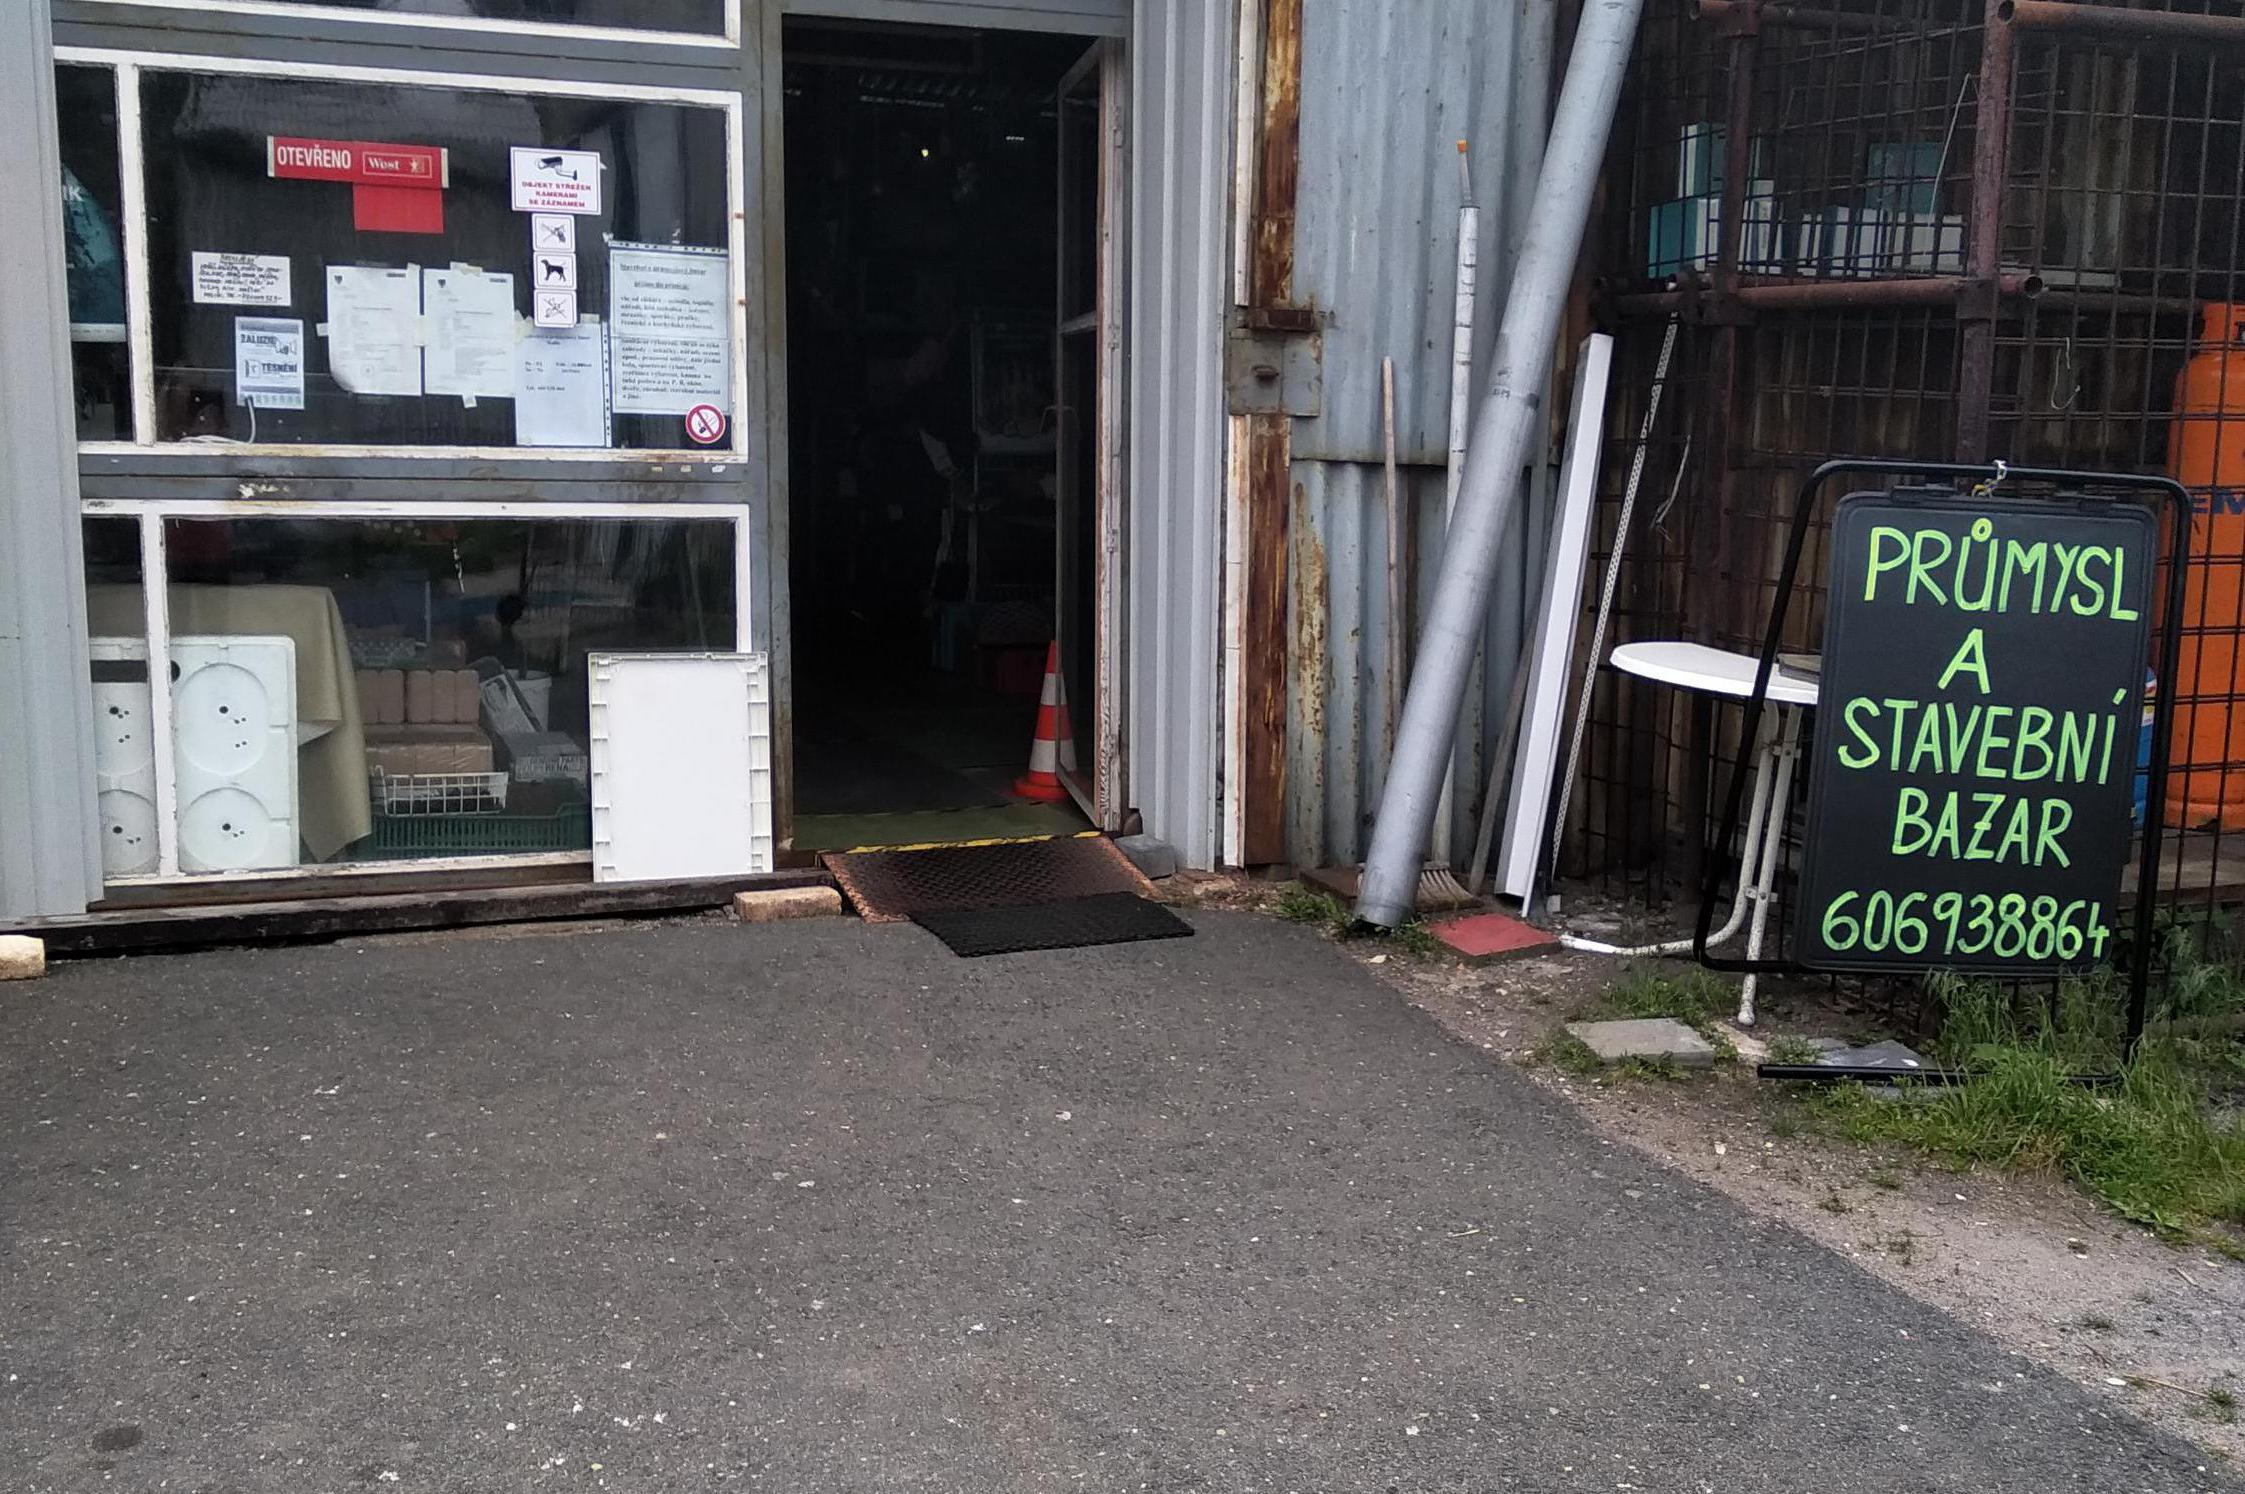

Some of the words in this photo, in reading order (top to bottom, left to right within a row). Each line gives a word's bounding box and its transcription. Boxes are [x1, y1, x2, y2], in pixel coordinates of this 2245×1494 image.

[276, 144, 352, 169] OTEVŘENO
[522, 181, 553, 189] OBJEKT
[555, 182, 592, 191] STŘEŽEN
[535, 191, 578, 199] KAMERAMI
[541, 199, 585, 208] ZÁZNAMEM
[1864, 517, 2139, 621] PRŮMYSL
[1938, 628, 1991, 694] A
[1837, 687, 2127, 785] STAVEBNÍ
[1891, 787, 2073, 869] BAZAR
[1821, 890, 2110, 961] 606938864
